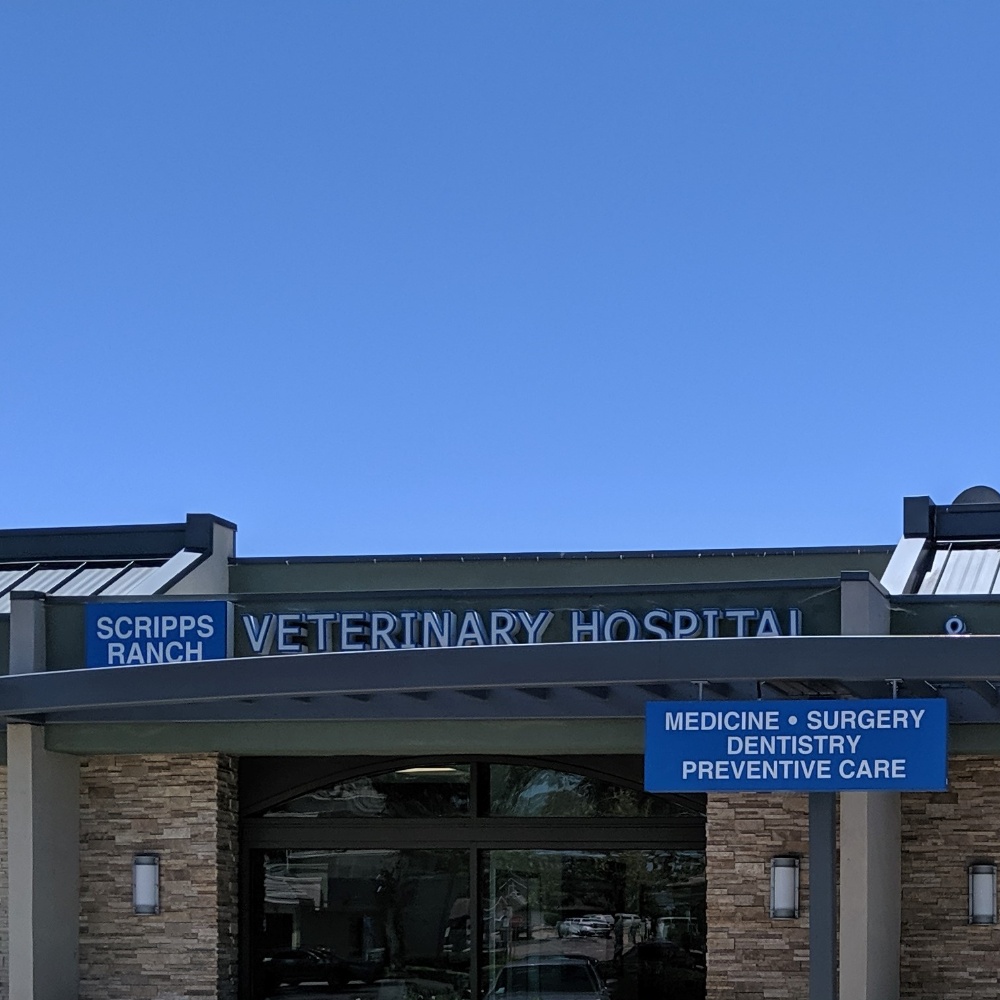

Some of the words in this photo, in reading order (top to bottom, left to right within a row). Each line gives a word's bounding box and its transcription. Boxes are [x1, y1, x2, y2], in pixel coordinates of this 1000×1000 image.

[96, 614, 215, 640] SCRIPPS
[241, 609, 553, 653] VETERINARY
[107, 640, 203, 665] RANCH
[665, 711, 780, 731] MEDICINE
[806, 709, 925, 730] SURGERY
[727, 735, 861, 755] DENTISTRY
[682, 760, 831, 780] PREVENTIVE
[838, 759, 906, 779] CARE
